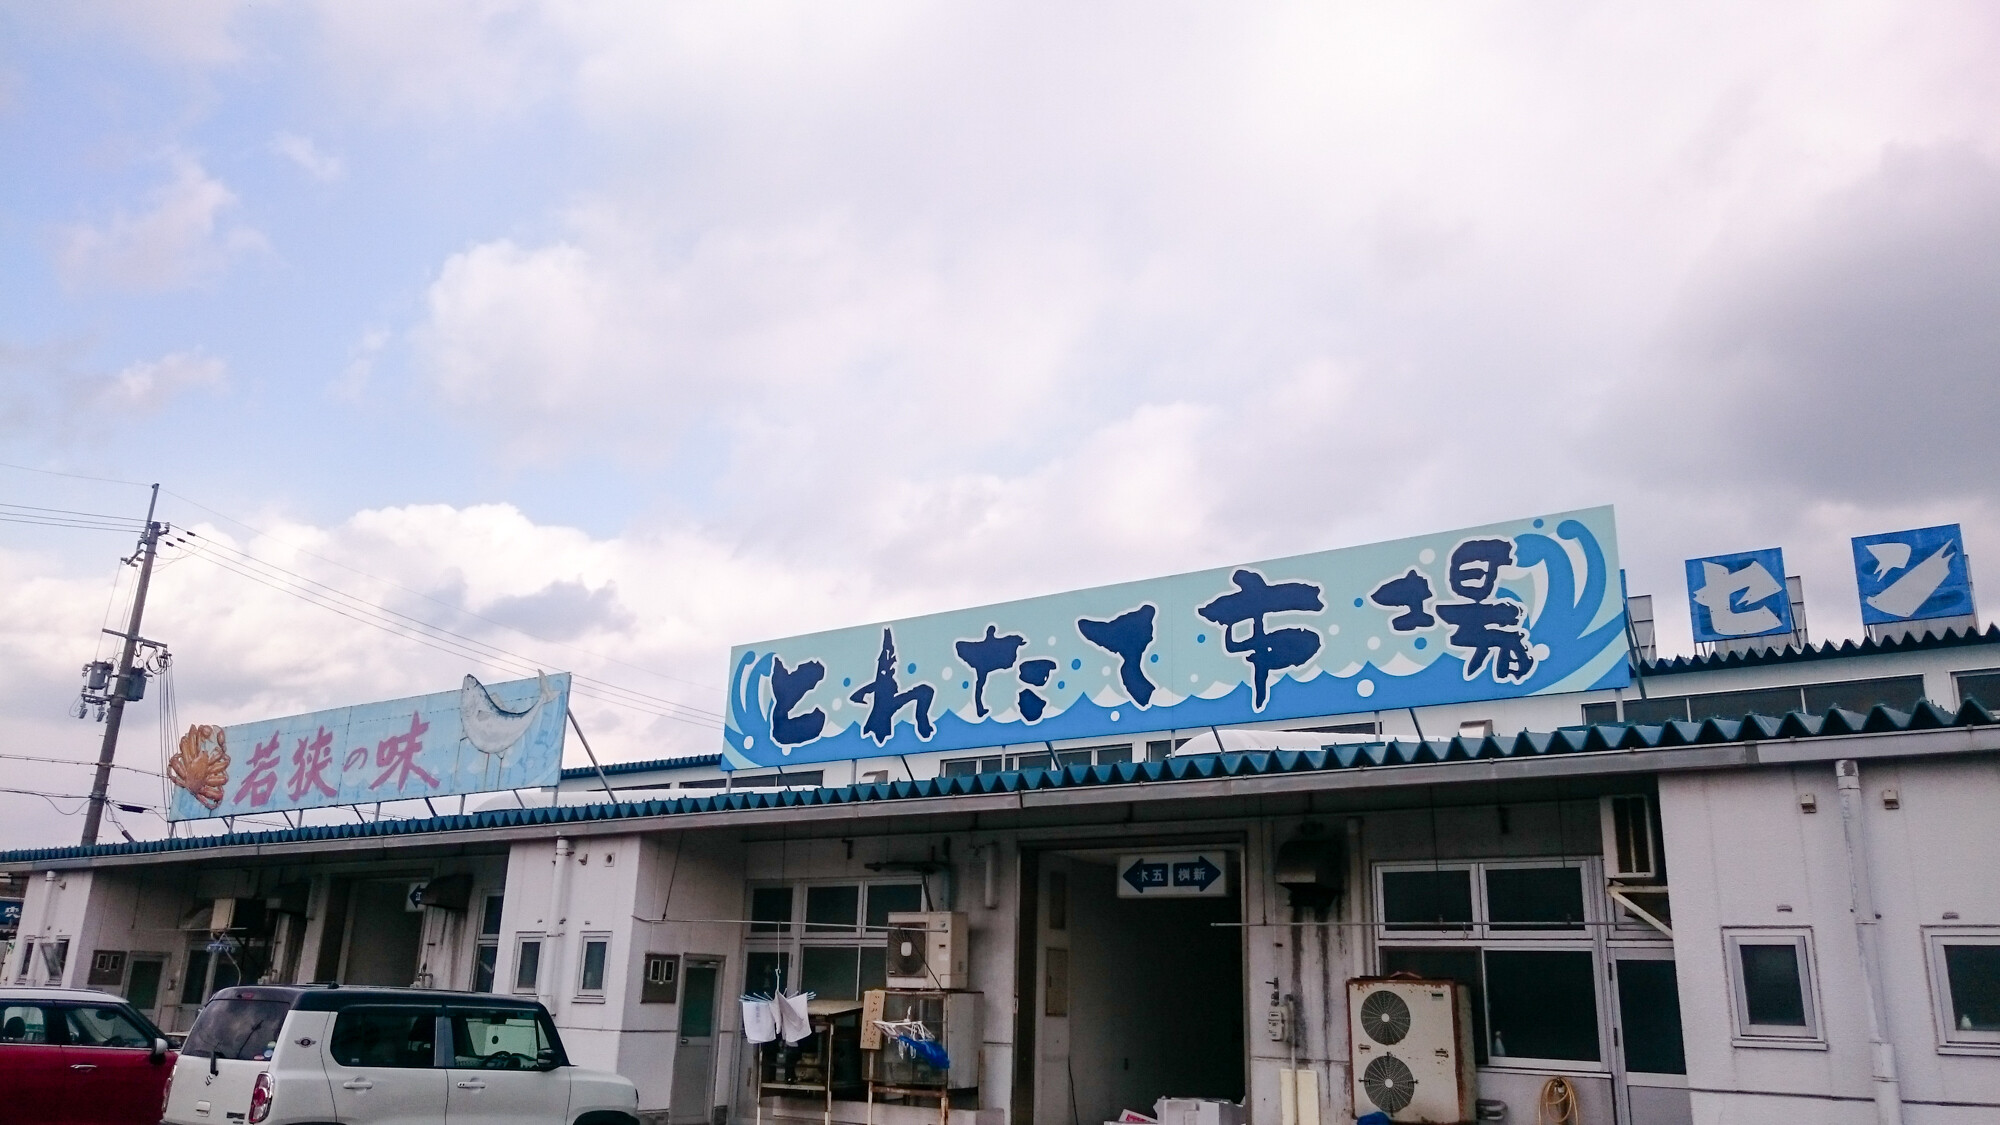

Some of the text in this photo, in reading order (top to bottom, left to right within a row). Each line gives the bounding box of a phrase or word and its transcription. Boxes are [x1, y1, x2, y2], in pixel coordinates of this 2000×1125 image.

[772, 537, 1534, 747] とれたて市場
[234, 710, 440, 806] 若狭の味
